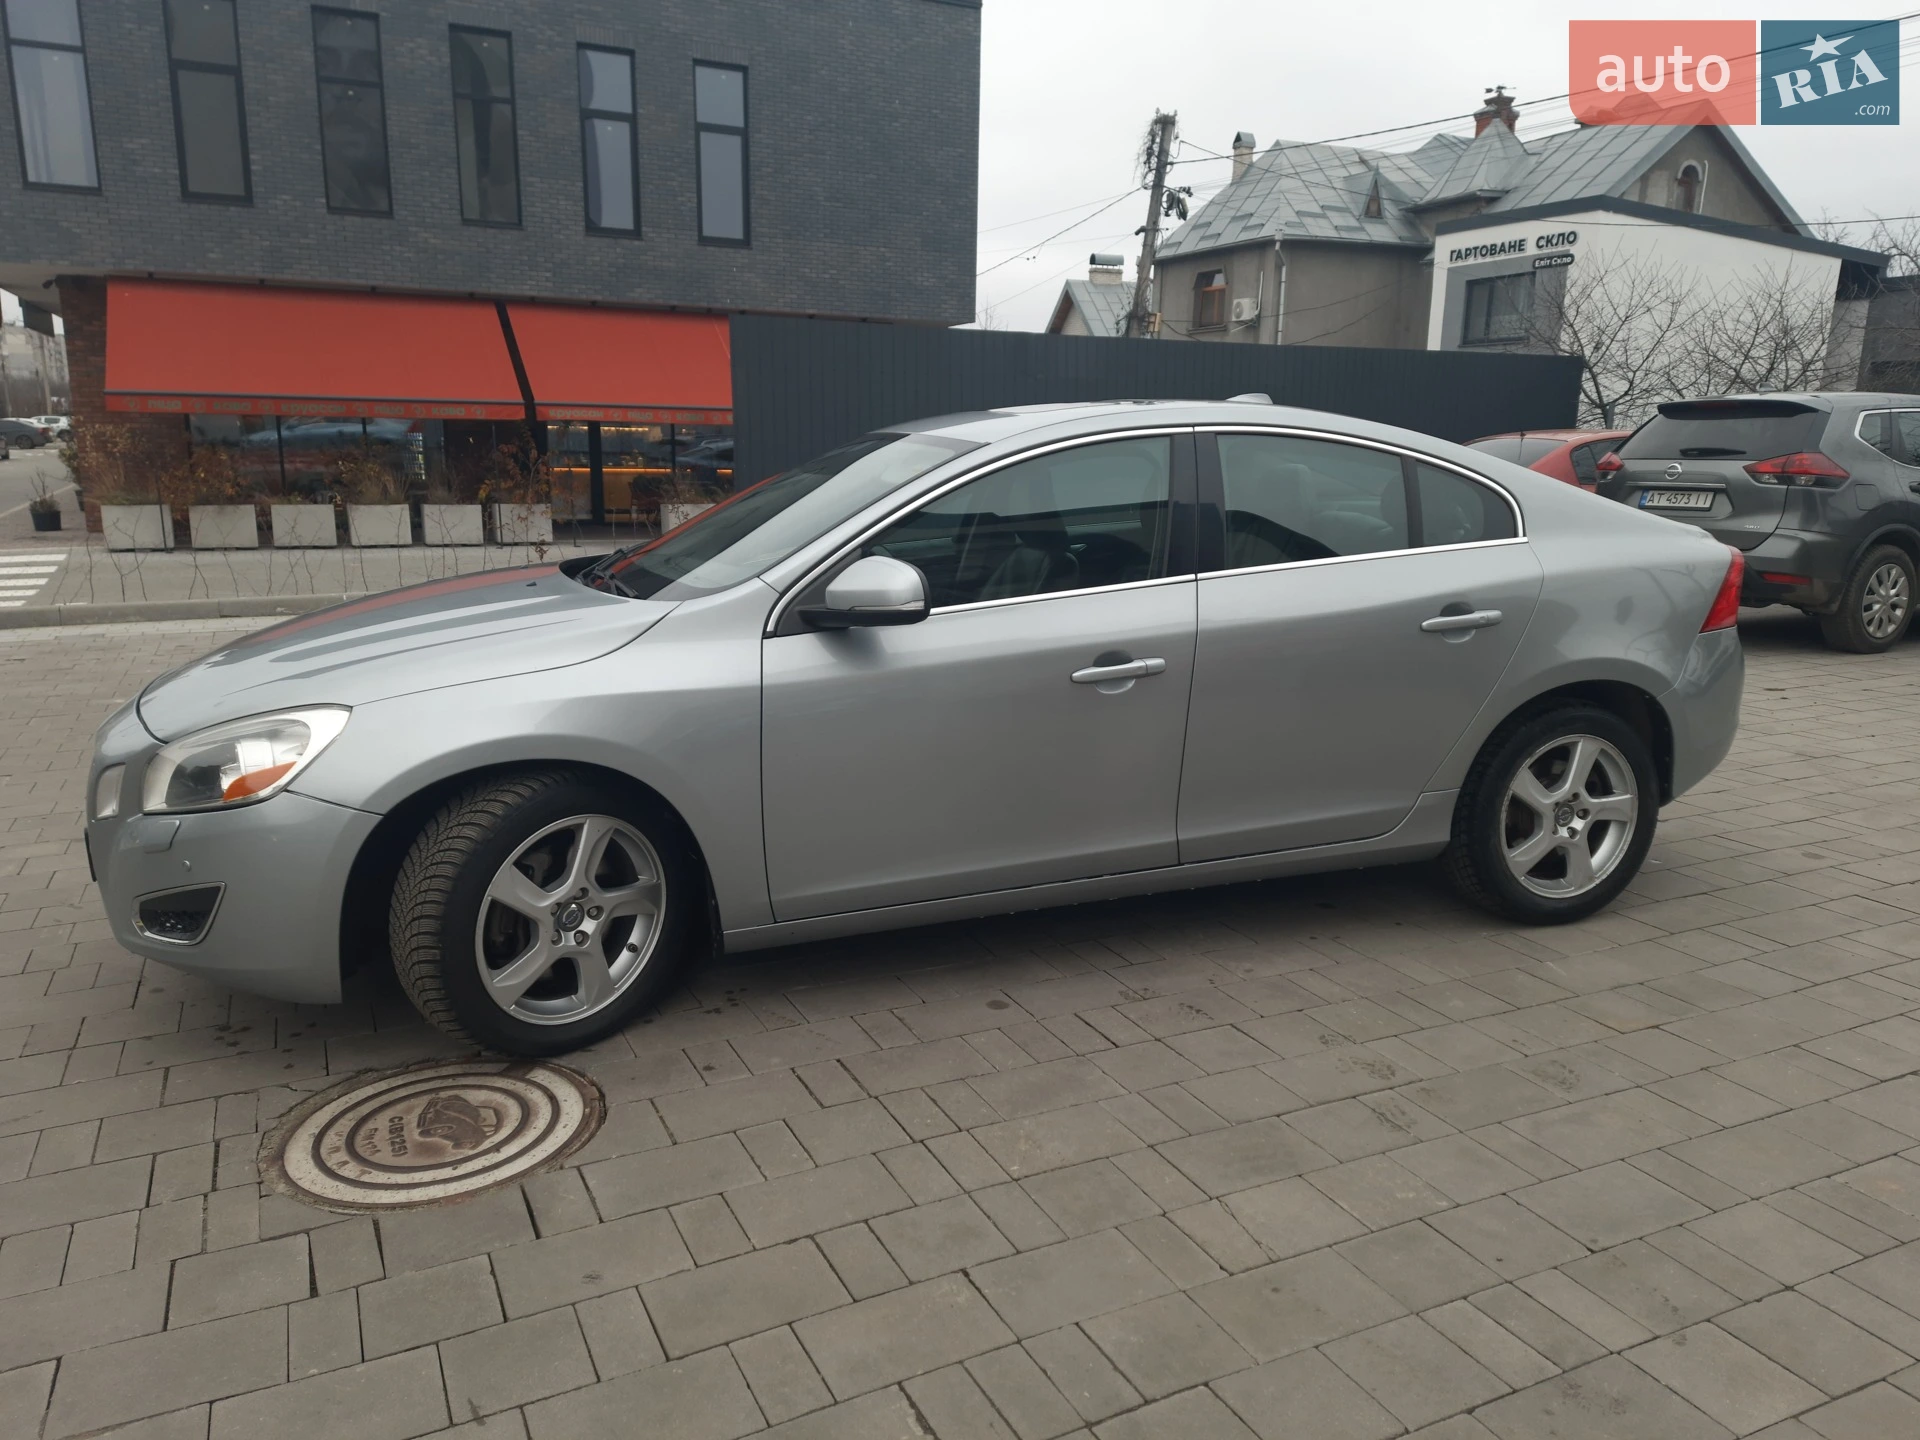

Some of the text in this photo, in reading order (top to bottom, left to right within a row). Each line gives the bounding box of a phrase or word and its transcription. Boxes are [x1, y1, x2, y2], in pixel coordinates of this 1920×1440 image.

[1450, 231, 1578, 262] ГАРТОВАНЕ СКЛО
[1666, 493, 1692, 504] 4573
